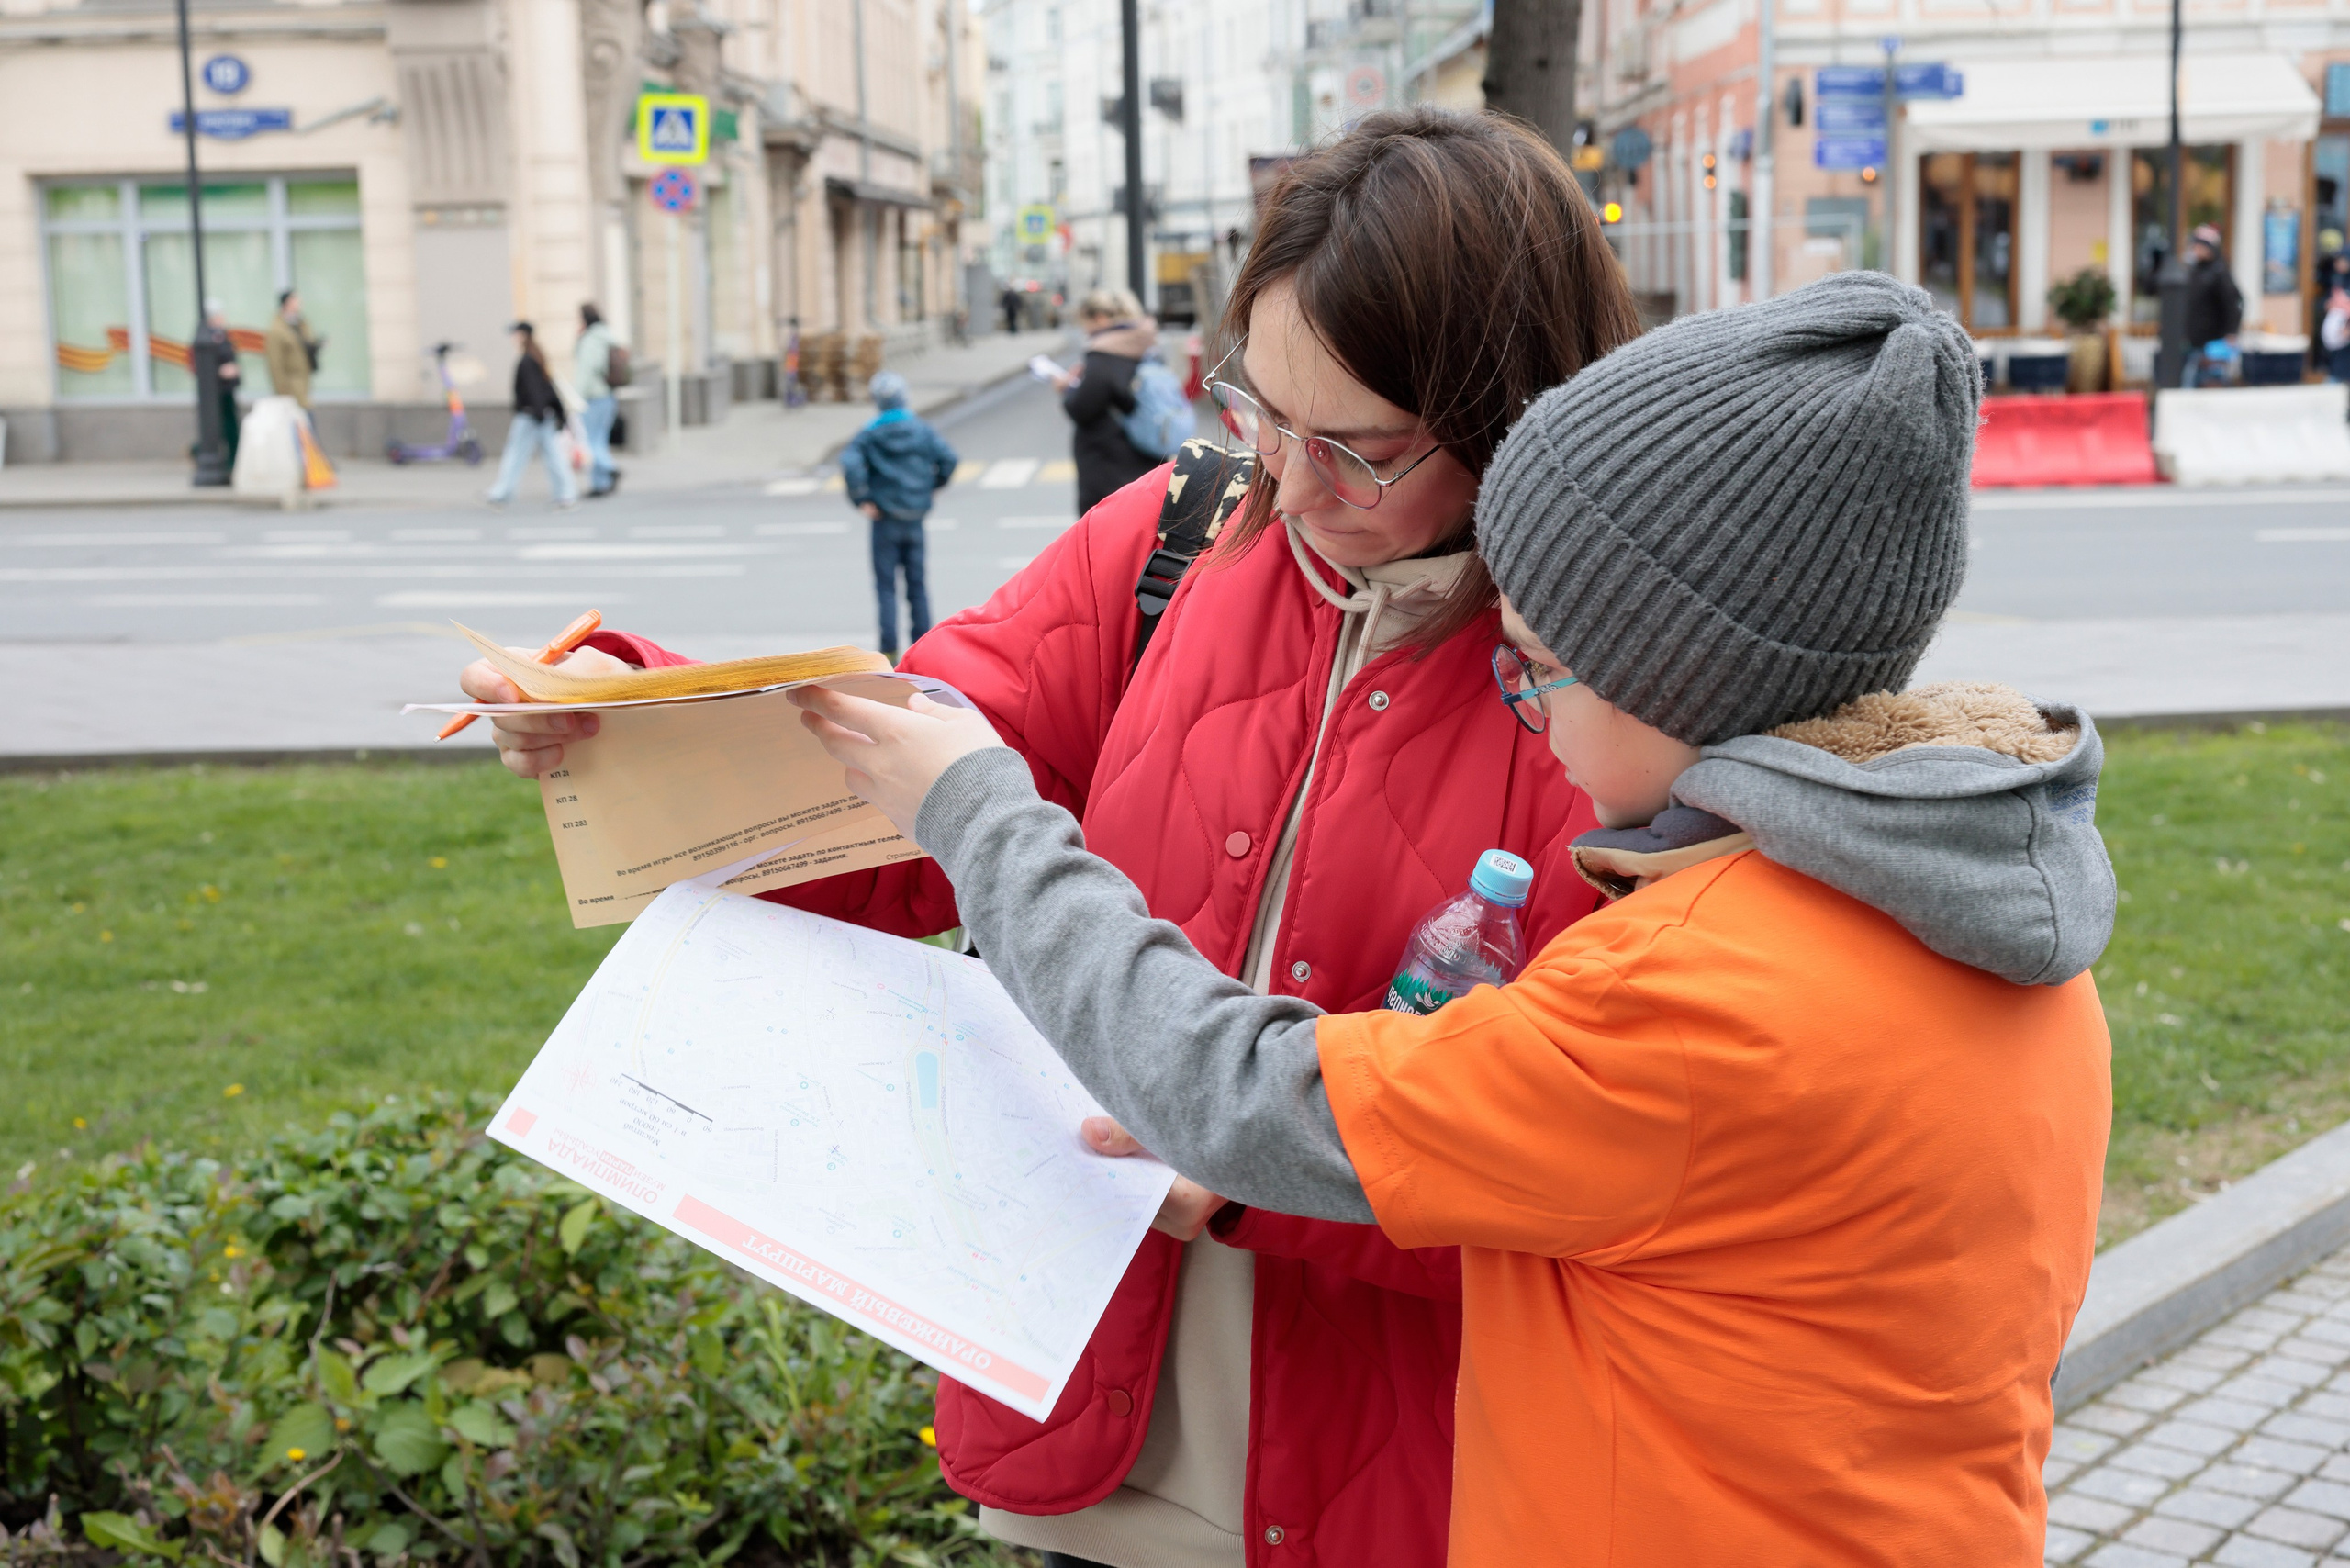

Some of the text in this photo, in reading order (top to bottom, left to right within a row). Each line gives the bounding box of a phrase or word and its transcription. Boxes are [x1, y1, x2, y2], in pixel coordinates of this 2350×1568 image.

[550, 770, 561, 778] КП
[556, 796, 567, 804] КП
[563, 819, 588, 830] КП 283
[627, 863, 652, 874] время
[653, 856, 673, 866] игры
[688, 831, 743, 854] возникающие
[744, 819, 777, 834] вопросы
[790, 806, 820, 818] можете
[821, 799, 848, 809] задать
[692, 840, 739, 861] 89150399116
[744, 834, 758, 843] орг.
[760, 823, 795, 837] вопросы,
[796, 807, 842, 825] 89150667499
[756, 857, 787, 868] можете
[789, 852, 815, 861] задать
[827, 839, 876, 853] контактным
[886, 849, 921, 860] Страница
[724, 873, 761, 885] вопросы,
[762, 860, 808, 877] 89150667499
[813, 854, 848, 865] задания.
[589, 895, 614, 903] время
[626, 1085, 641, 1097] 180
[617, 1095, 649, 1117] метров
[644, 1094, 659, 1106] 120
[665, 1104, 677, 1115] 60
[632, 1115, 661, 1136] 1:6000
[647, 1112, 661, 1125] 60
[685, 1114, 693, 1124] 0
[621, 1121, 661, 1147] Масштаб
[701, 1123, 713, 1134] 60
[552, 1126, 666, 1192] МУЗЕИ ПАРКИ УСАДЬБЫ
[543, 1137, 660, 1205] ОЛИМПИАДА
[740, 1230, 849, 1297] МАРШРУТ
[847, 1284, 995, 1374] ОРАНЖЕВЫЙ
